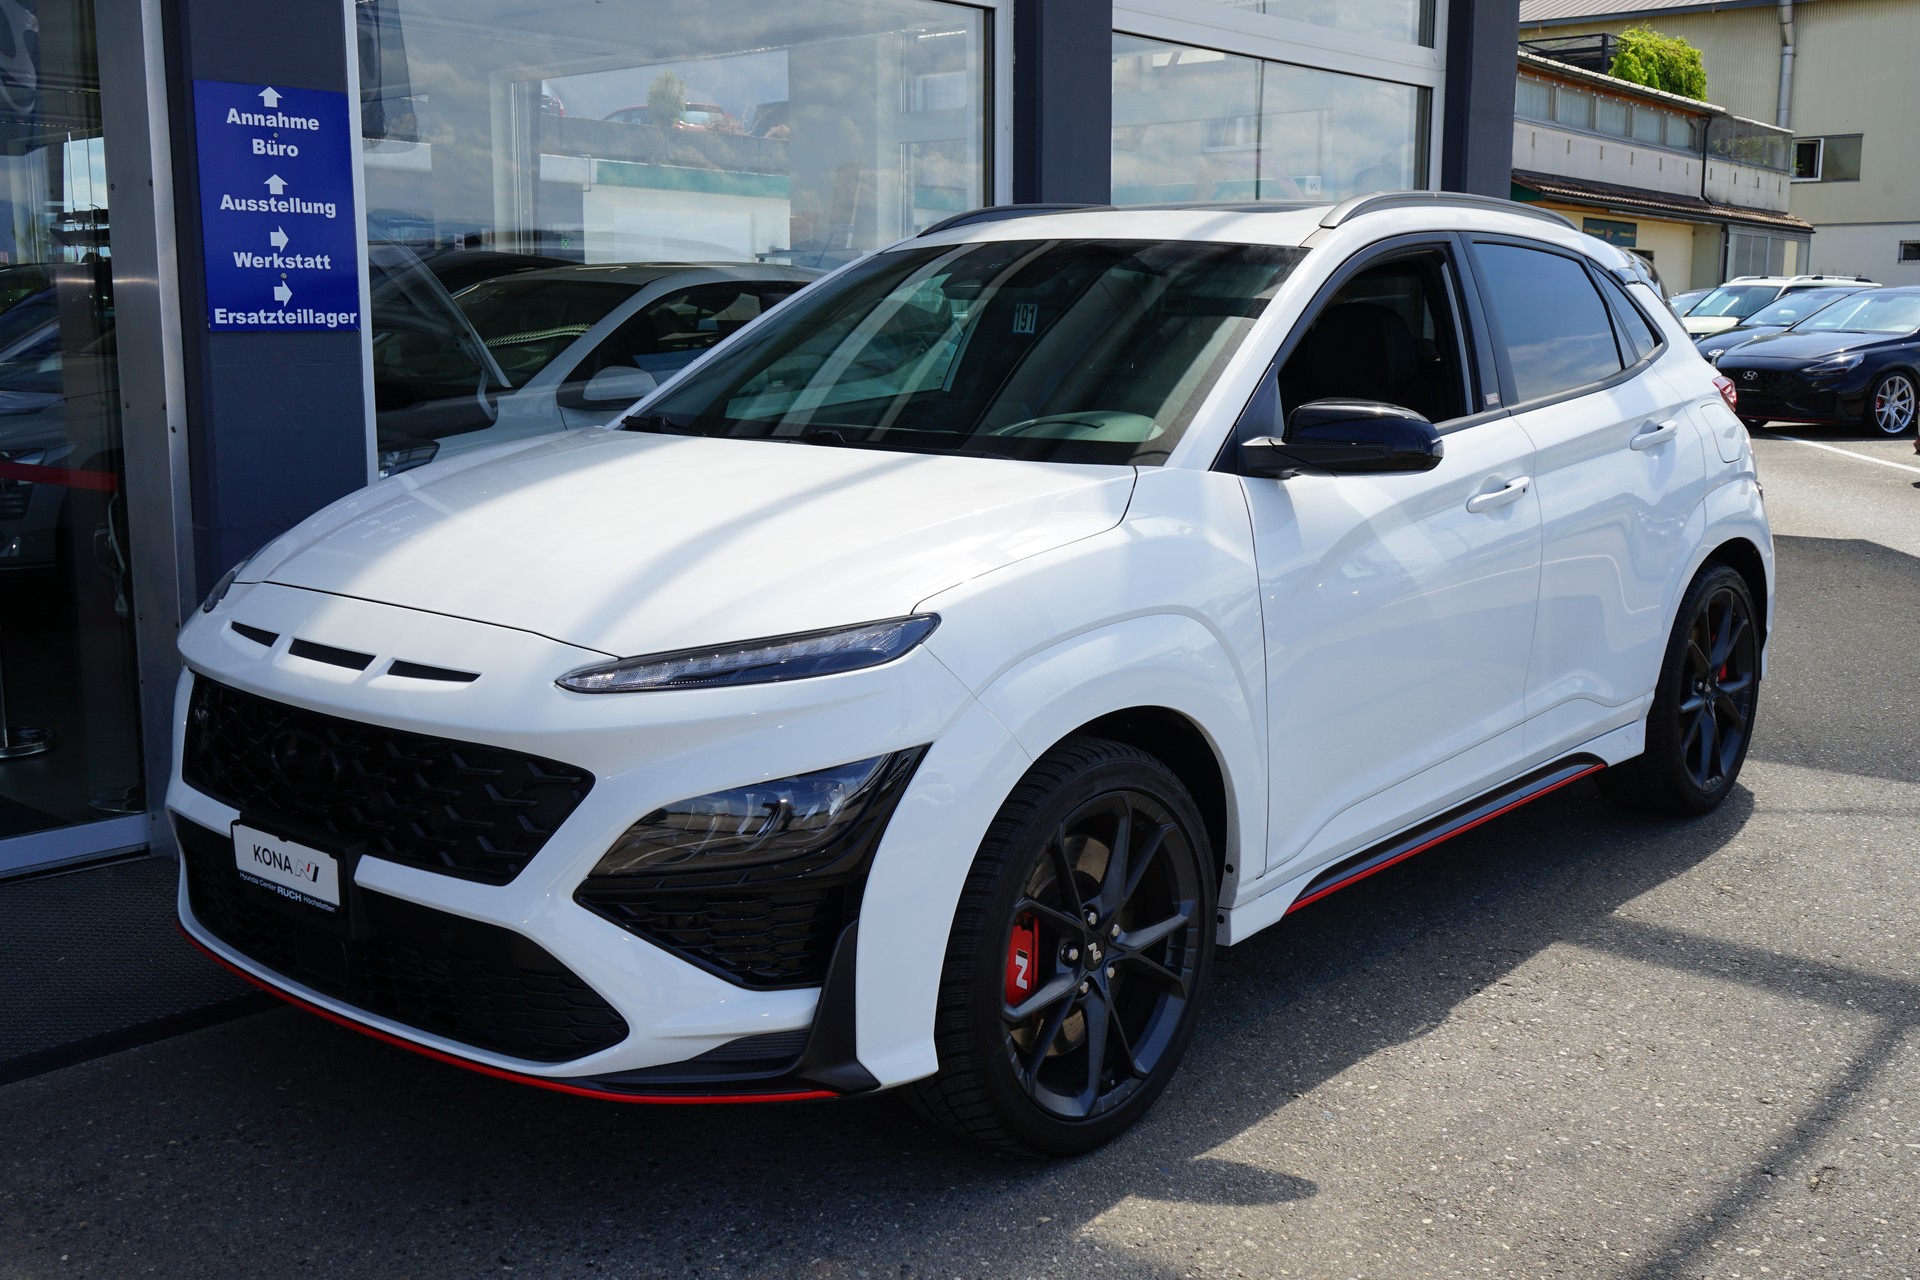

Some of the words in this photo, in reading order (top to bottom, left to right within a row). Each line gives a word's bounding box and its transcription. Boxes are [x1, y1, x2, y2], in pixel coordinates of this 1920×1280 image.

[226, 107, 320, 131] Annahme
[252, 139, 298, 157] Büro
[219, 194, 337, 219] Ausstellung
[233, 251, 332, 270] Werkstatt
[213, 308, 358, 329] Ersatzteillager
[1015, 305, 1036, 331] 191
[253, 844, 293, 874] KONA
[260, 880, 277, 891] Center
[277, 887, 301, 901] RUCH
